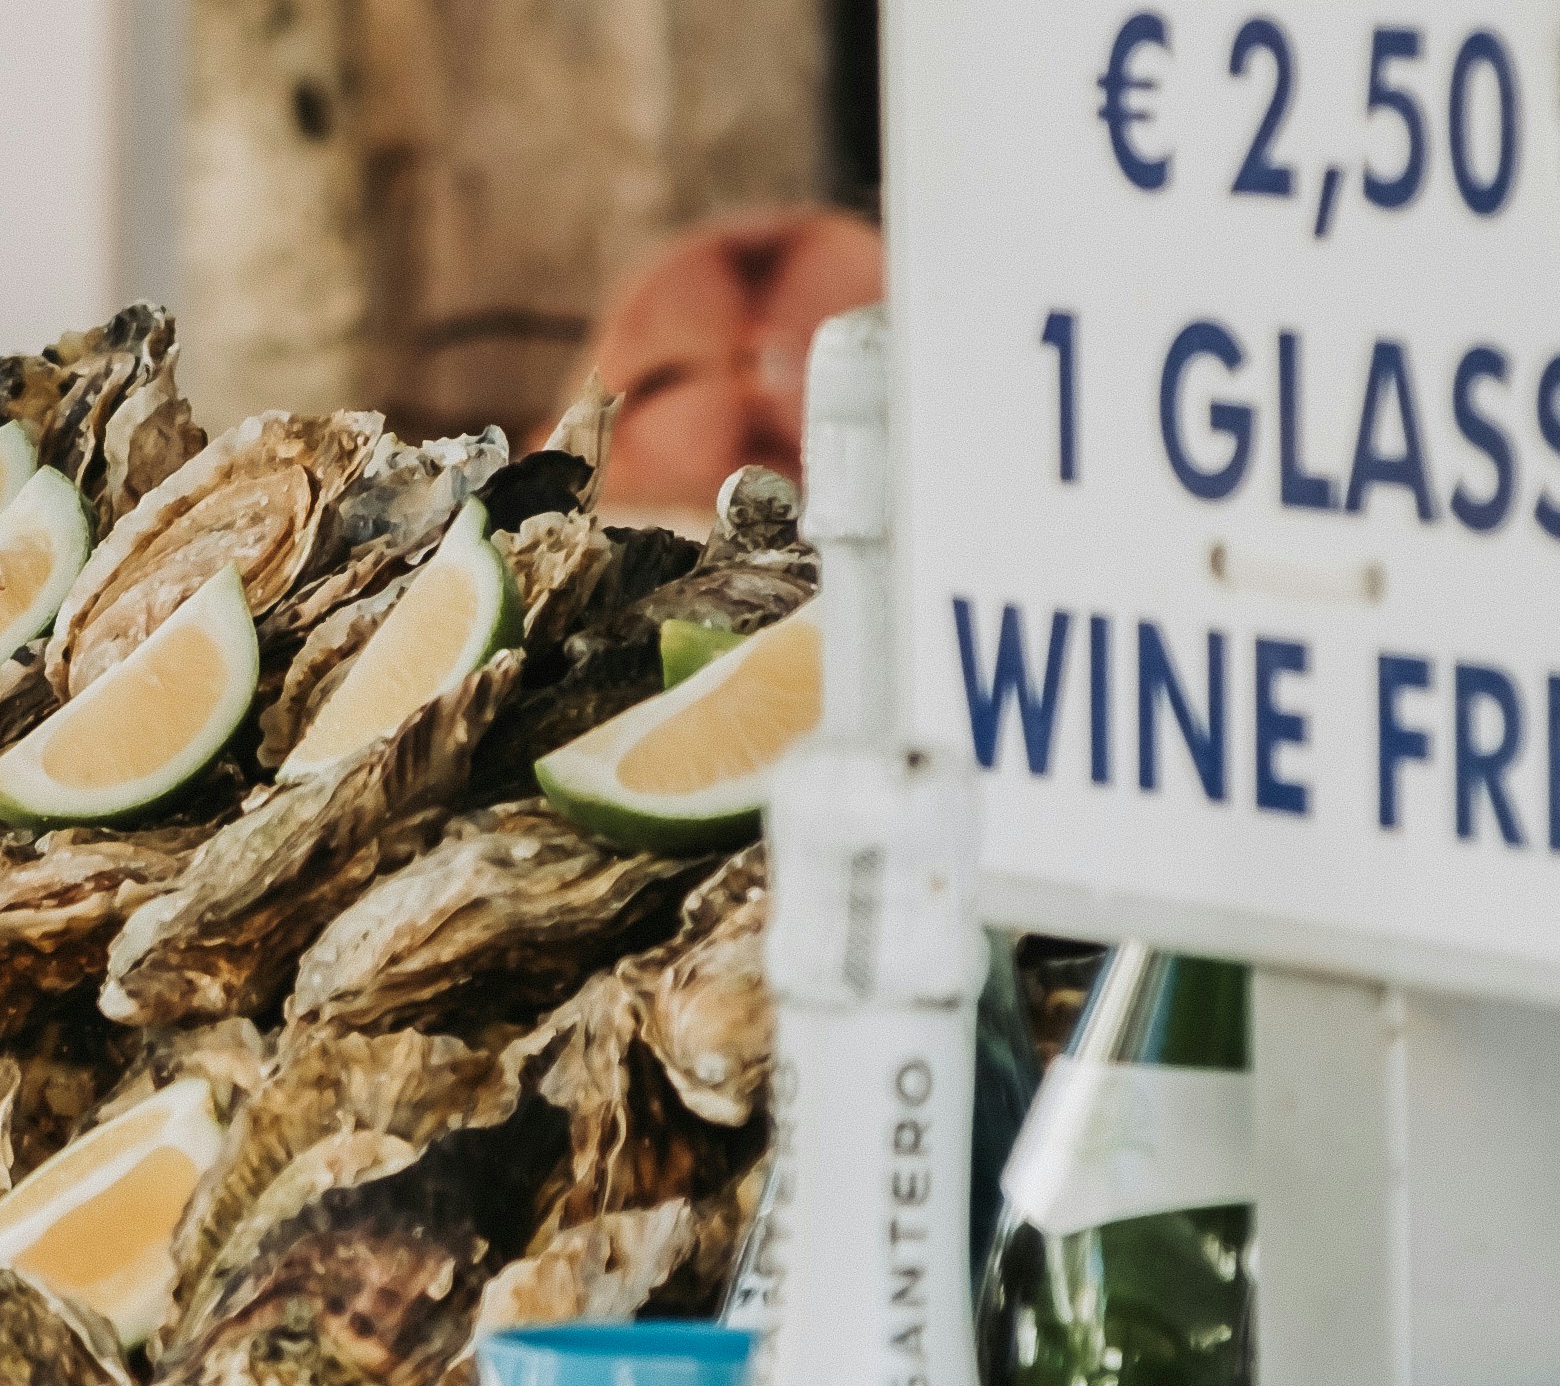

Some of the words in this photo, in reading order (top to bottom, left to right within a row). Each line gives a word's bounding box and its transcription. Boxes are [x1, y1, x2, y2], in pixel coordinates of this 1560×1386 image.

[1094, 12, 1174, 194] €
[1226, 15, 1521, 241] 2,50
[1039, 309, 1079, 486] 1
[950, 594, 1312, 817] WINE
